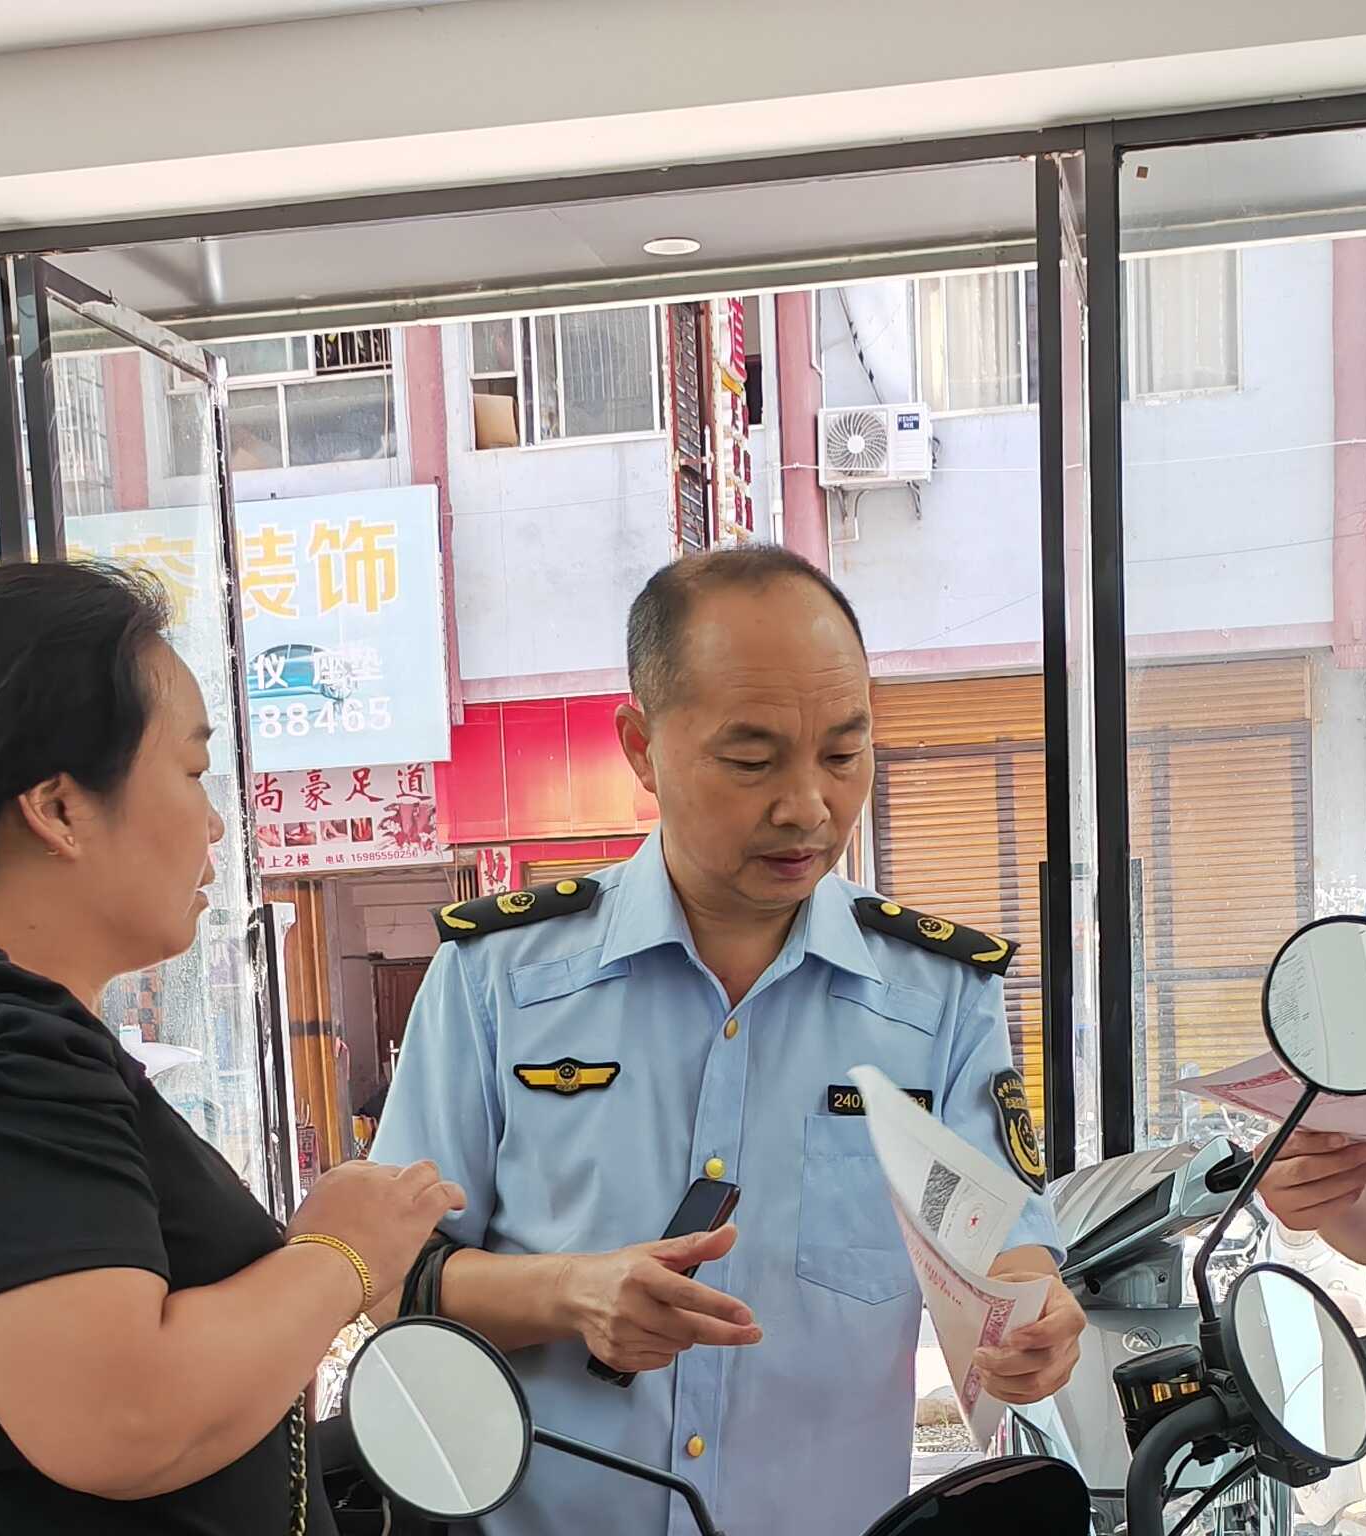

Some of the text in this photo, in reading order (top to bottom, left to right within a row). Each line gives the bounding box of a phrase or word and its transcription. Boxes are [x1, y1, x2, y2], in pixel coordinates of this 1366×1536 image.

[254, 763, 432, 813] 尚豪足道
[325, 854, 344, 865] 电话
